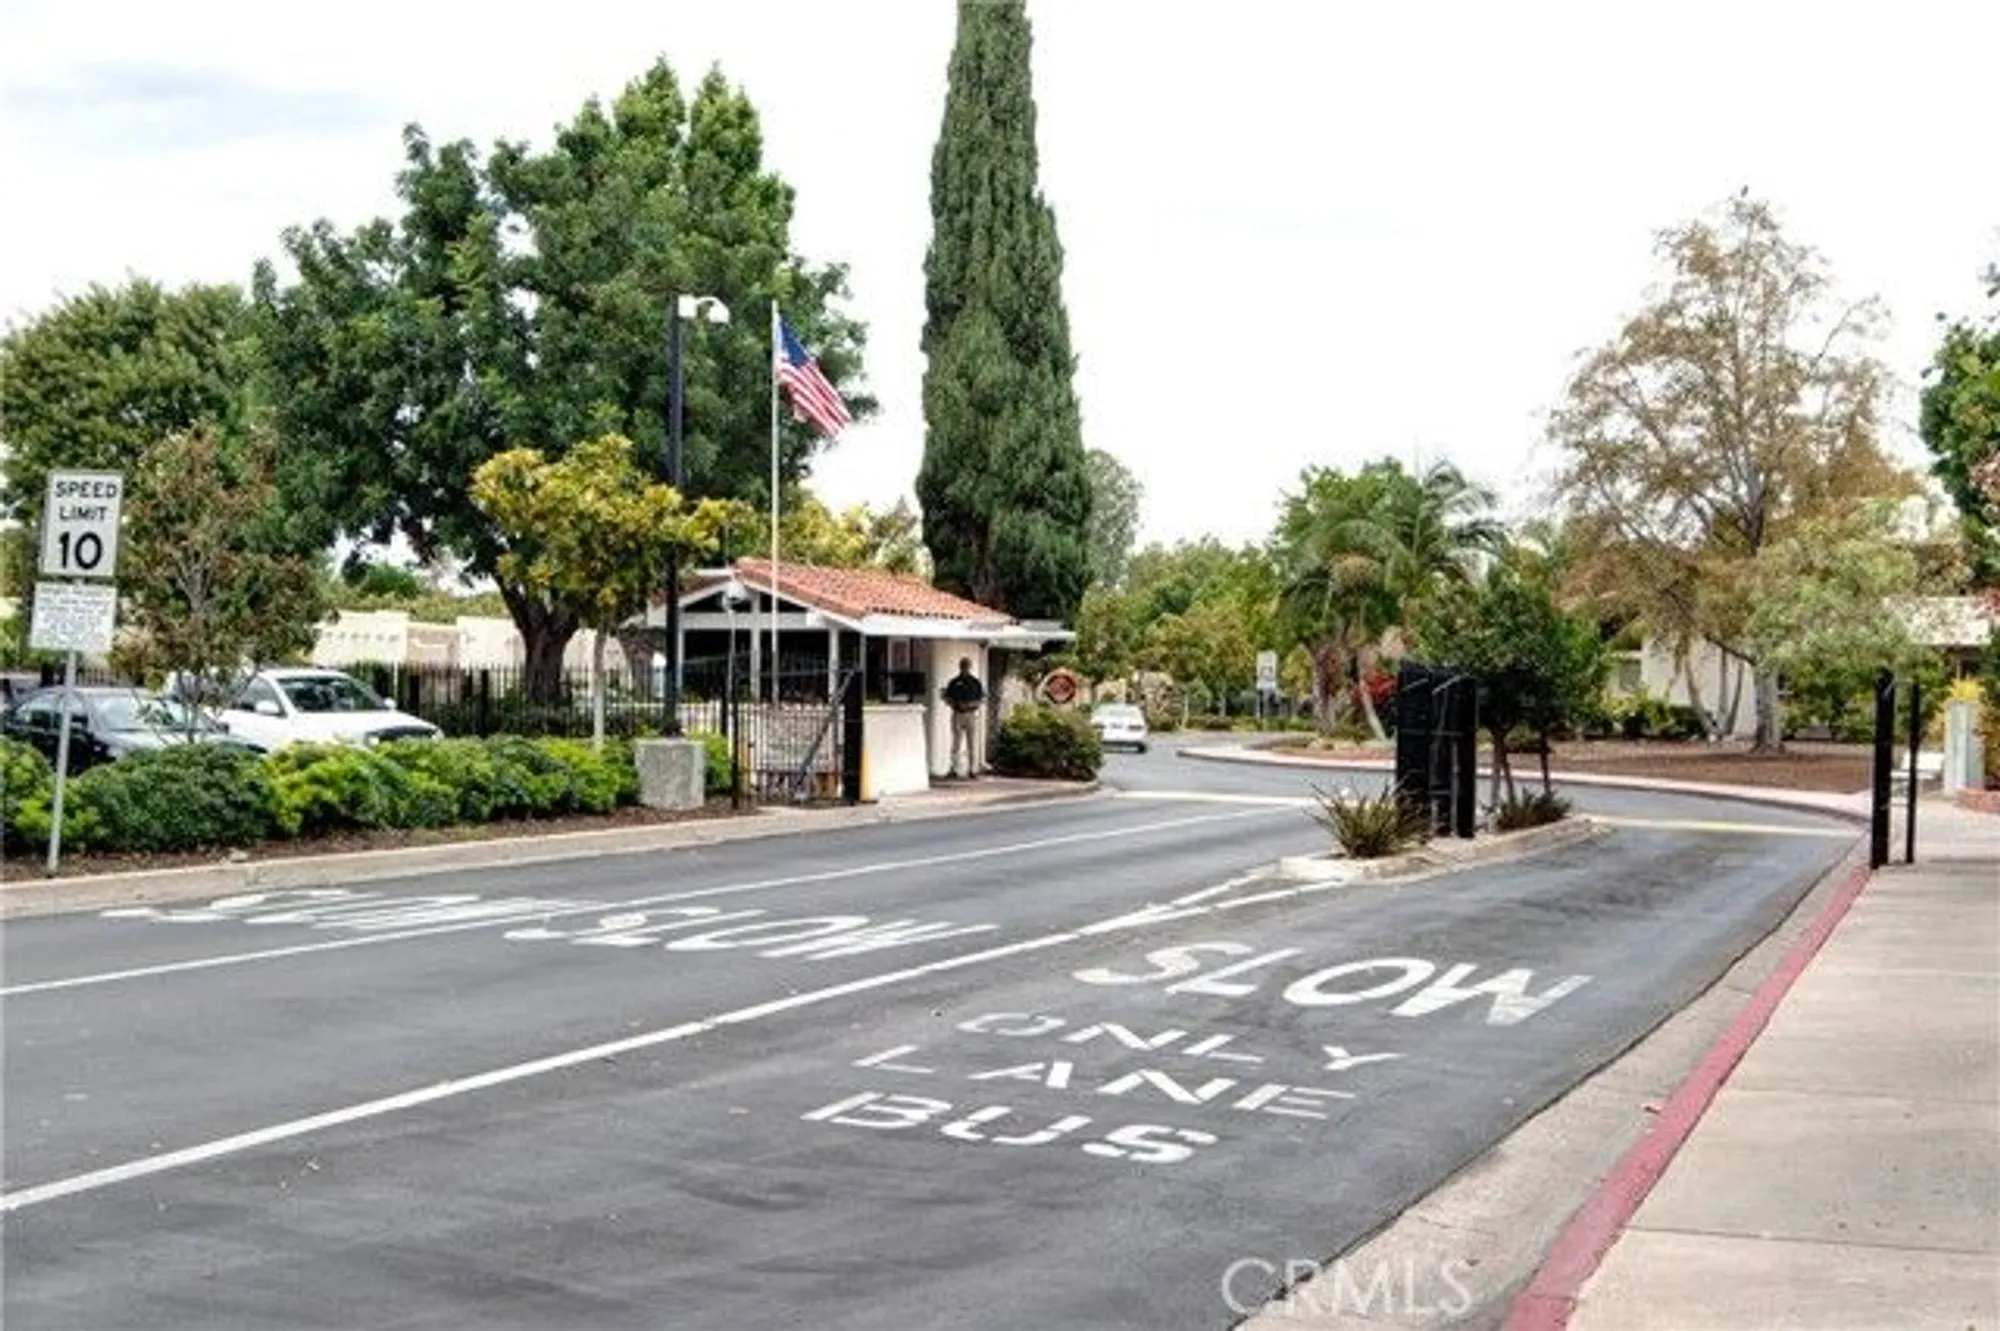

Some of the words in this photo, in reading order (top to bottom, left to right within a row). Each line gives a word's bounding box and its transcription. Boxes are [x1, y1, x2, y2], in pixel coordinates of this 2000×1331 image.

[56, 481, 118, 498] SPEED
[59, 505, 108, 521] LIMIT
[59, 531, 103, 570] 10
[503, 906, 999, 960] SLOW
[1074, 940, 1594, 1027] SLOW
[956, 1011, 1409, 1071] ONLY
[853, 1045, 1355, 1121] LANE
[803, 1091, 1217, 1165] BUS
